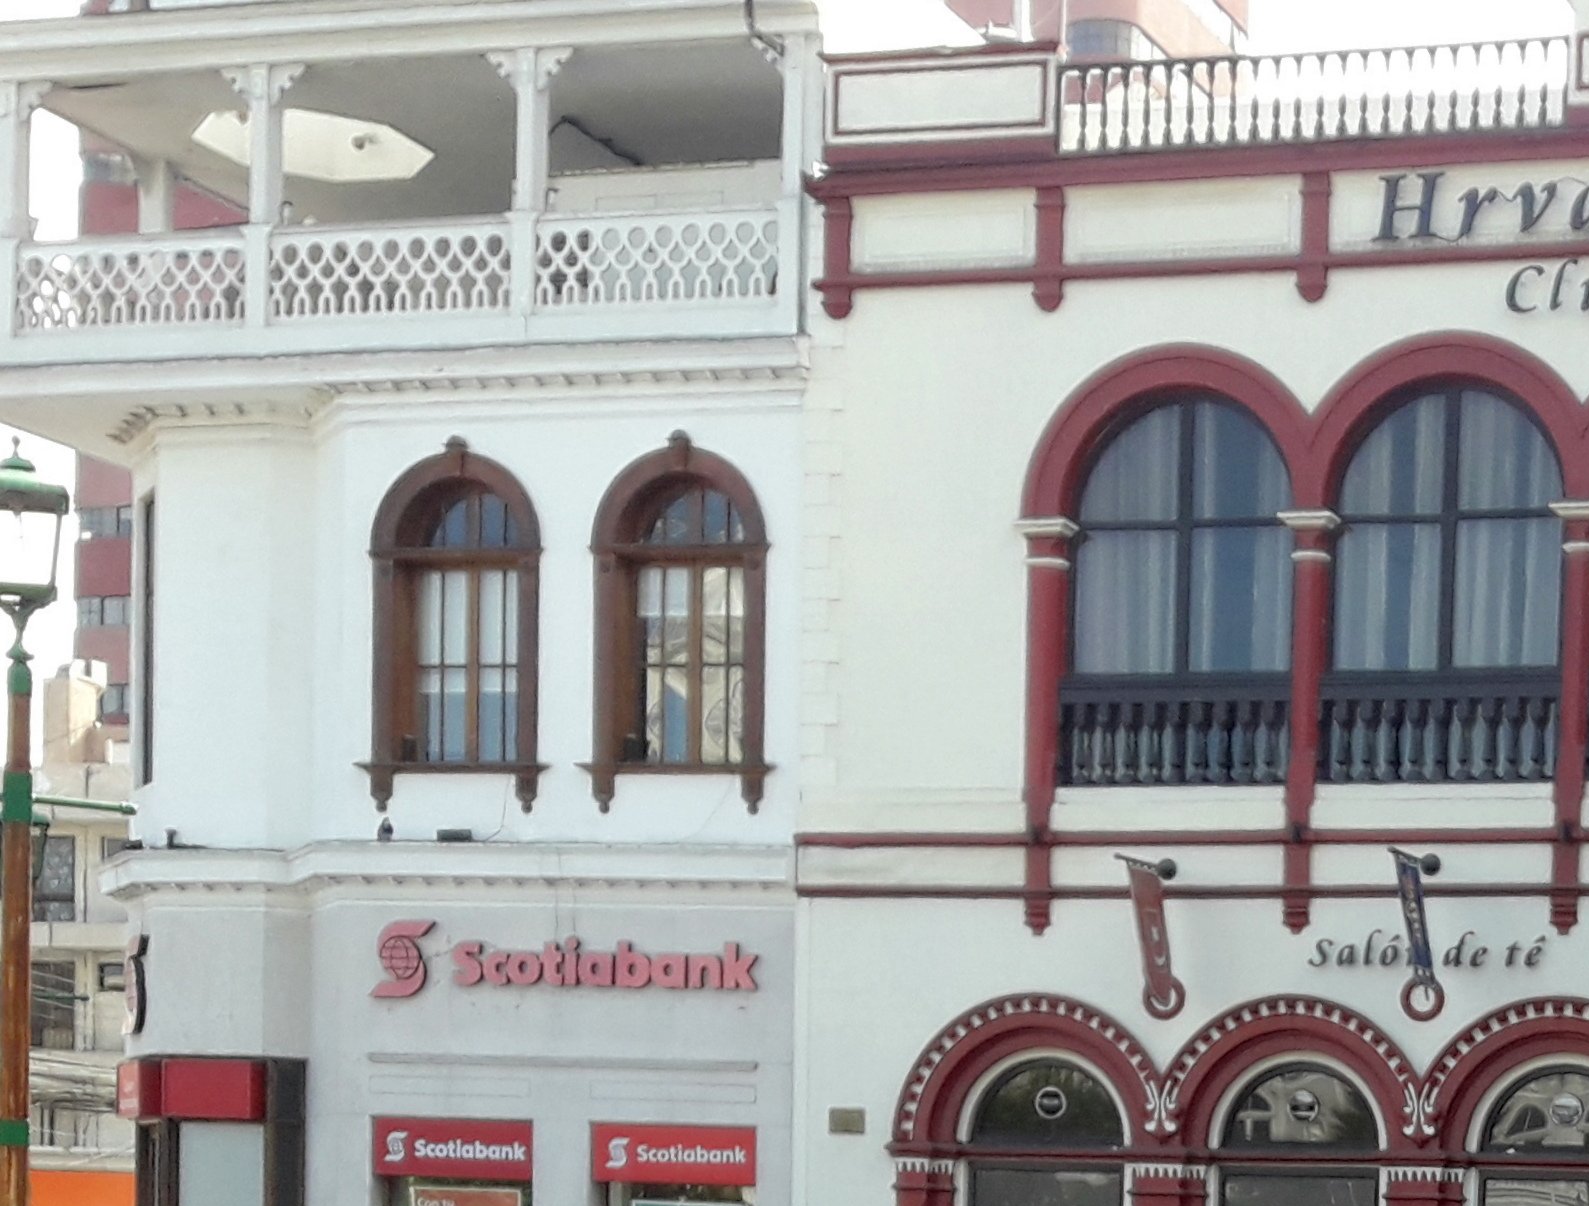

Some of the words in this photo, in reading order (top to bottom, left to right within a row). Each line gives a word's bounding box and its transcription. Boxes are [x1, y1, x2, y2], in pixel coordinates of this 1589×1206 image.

[452, 935, 758, 991] Scotiabank
[1442, 930, 1489, 968] de
[1505, 935, 1547, 968] té
[413, 1138, 527, 1162] Scotiabank
[636, 1144, 747, 1165] Scotiabank
